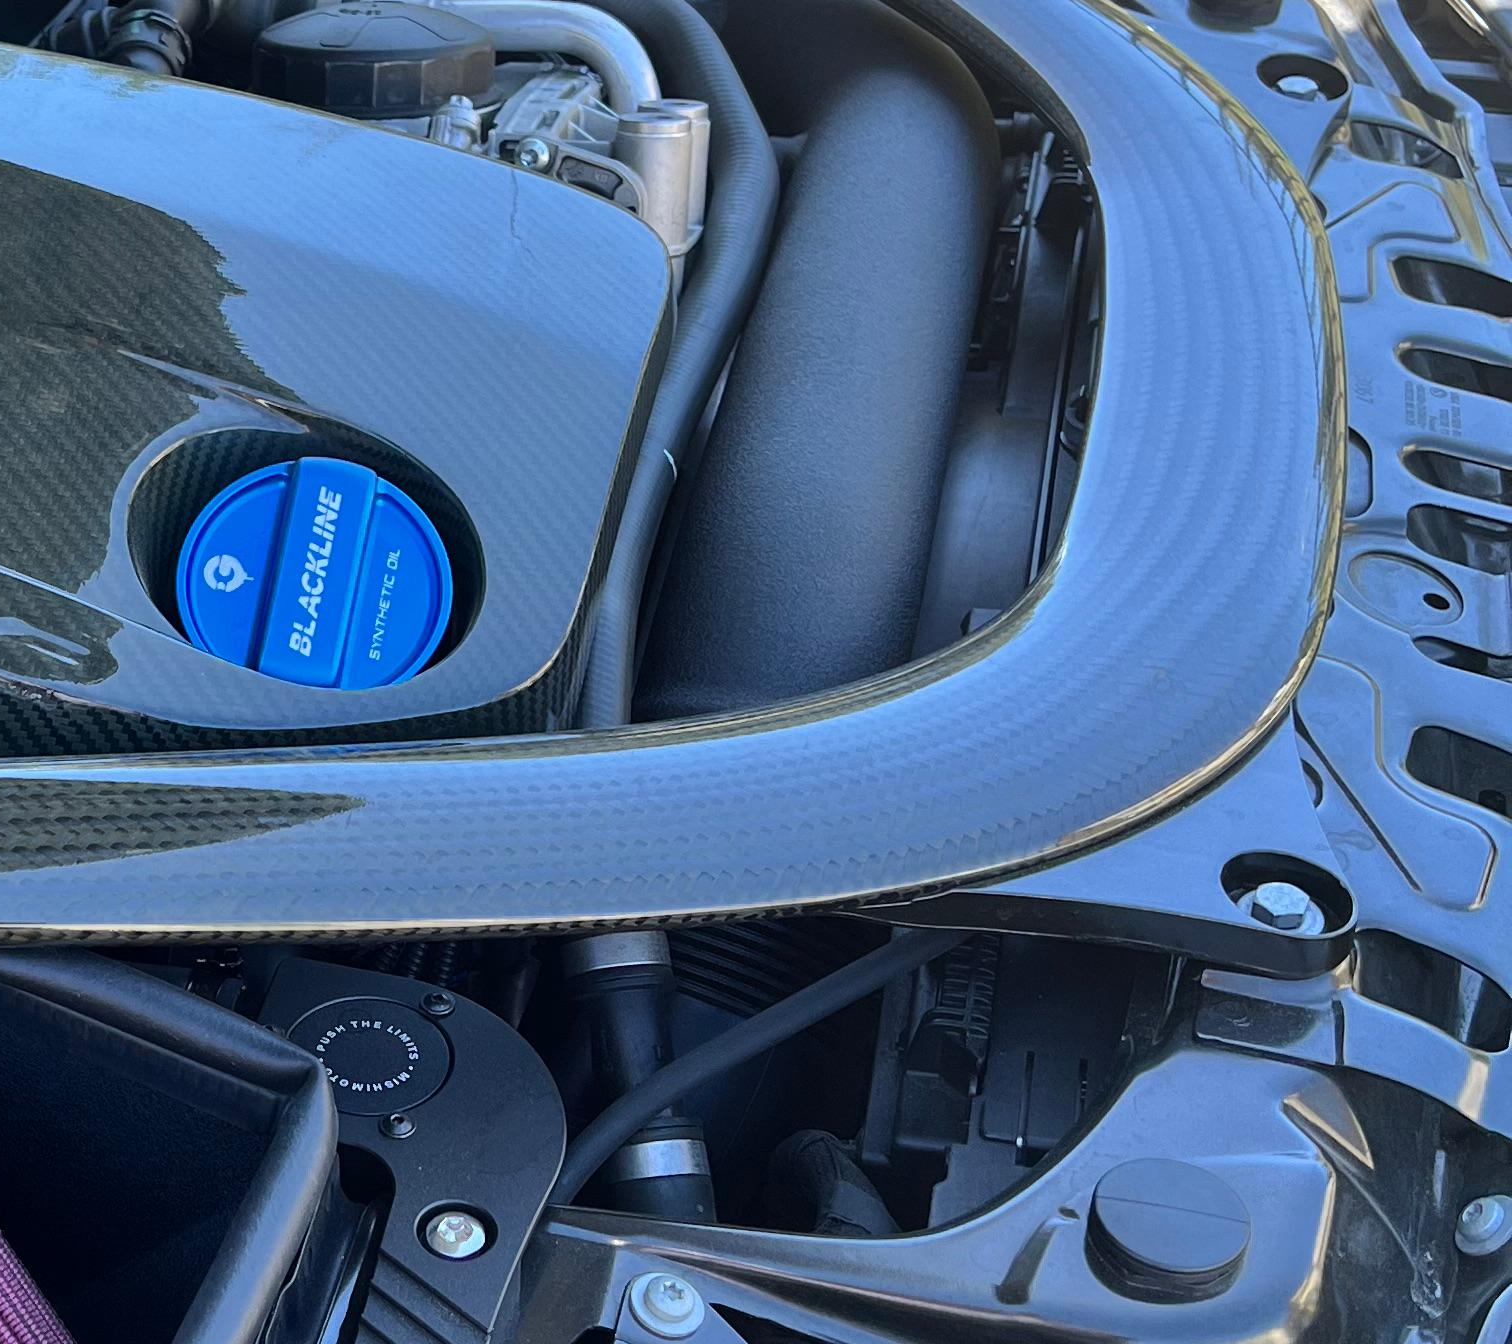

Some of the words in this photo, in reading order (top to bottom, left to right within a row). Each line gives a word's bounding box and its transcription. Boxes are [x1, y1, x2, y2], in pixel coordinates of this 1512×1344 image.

[289, 485, 343, 657] BLACKLINE
[368, 573, 397, 661] SYNTHETIC
[386, 548, 401, 571] OIL
[316, 1023, 346, 1053] PUSH
[349, 1019, 382, 1029] THE
[386, 1024, 419, 1061] LIMITS
